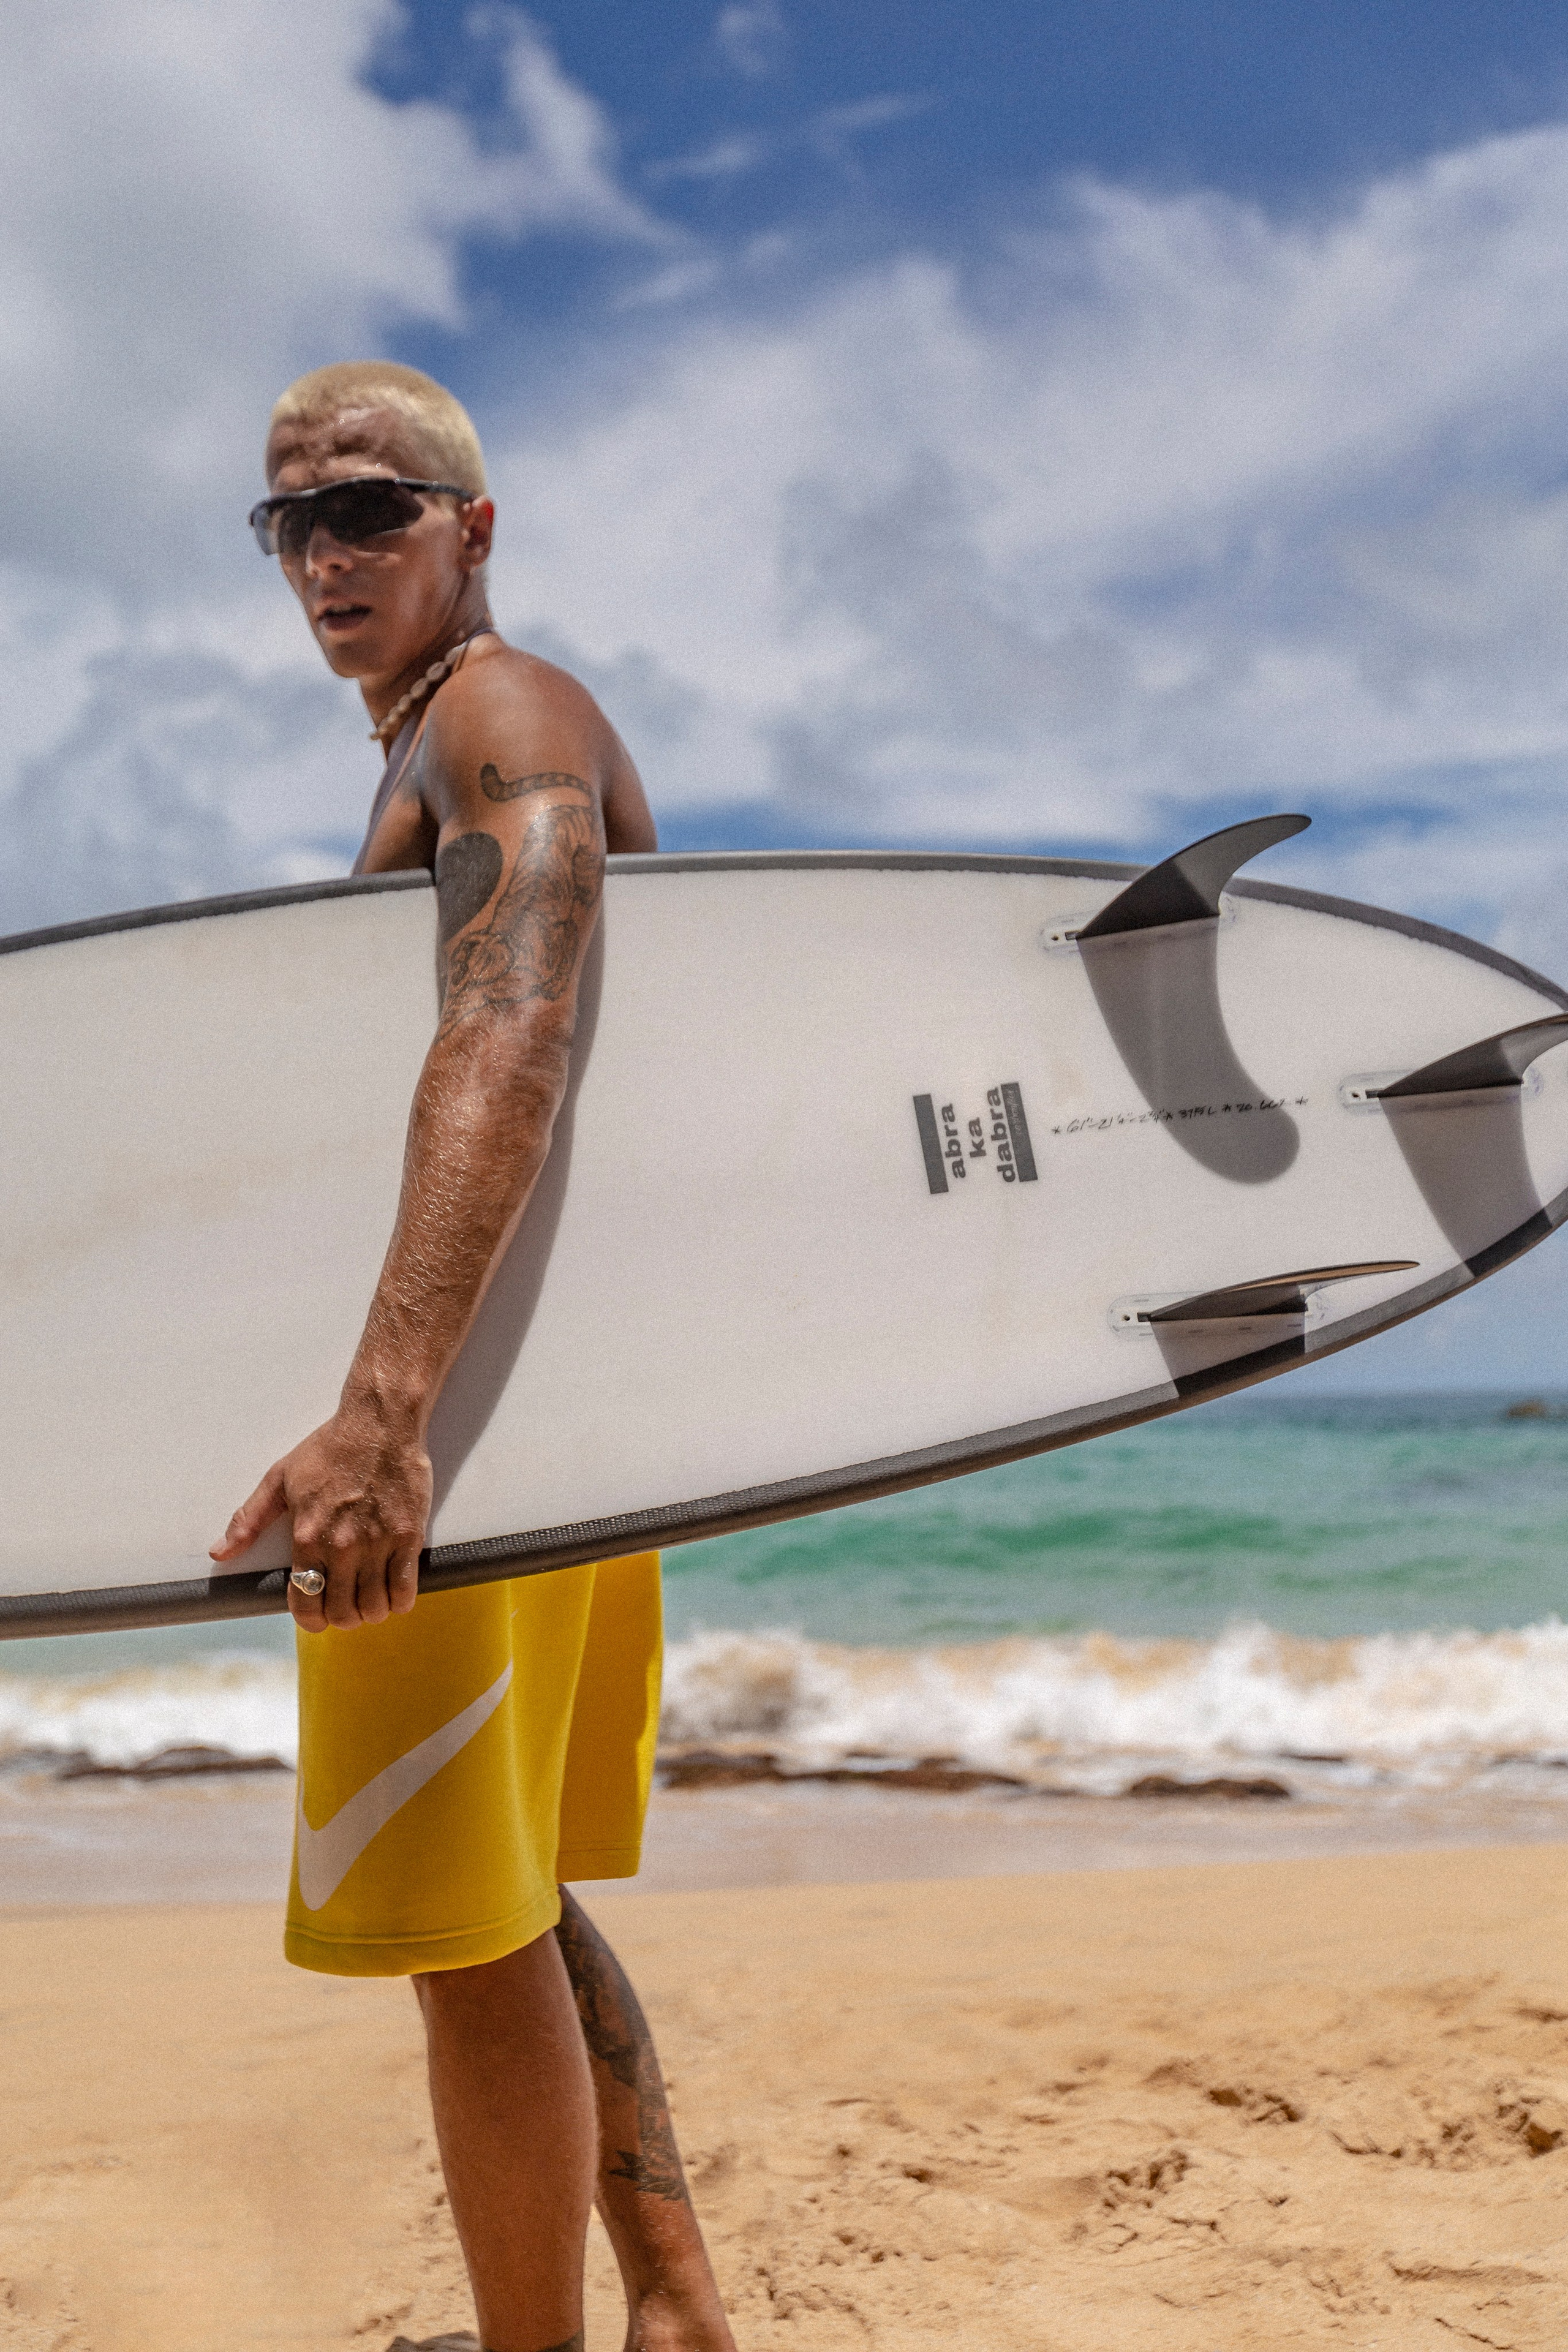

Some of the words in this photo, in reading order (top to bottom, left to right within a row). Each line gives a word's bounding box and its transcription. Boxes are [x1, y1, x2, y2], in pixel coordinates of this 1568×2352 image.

[941, 1104, 967, 1178] abra
[968, 1117, 987, 1158] ka
[987, 1086, 1016, 1183] dabra
